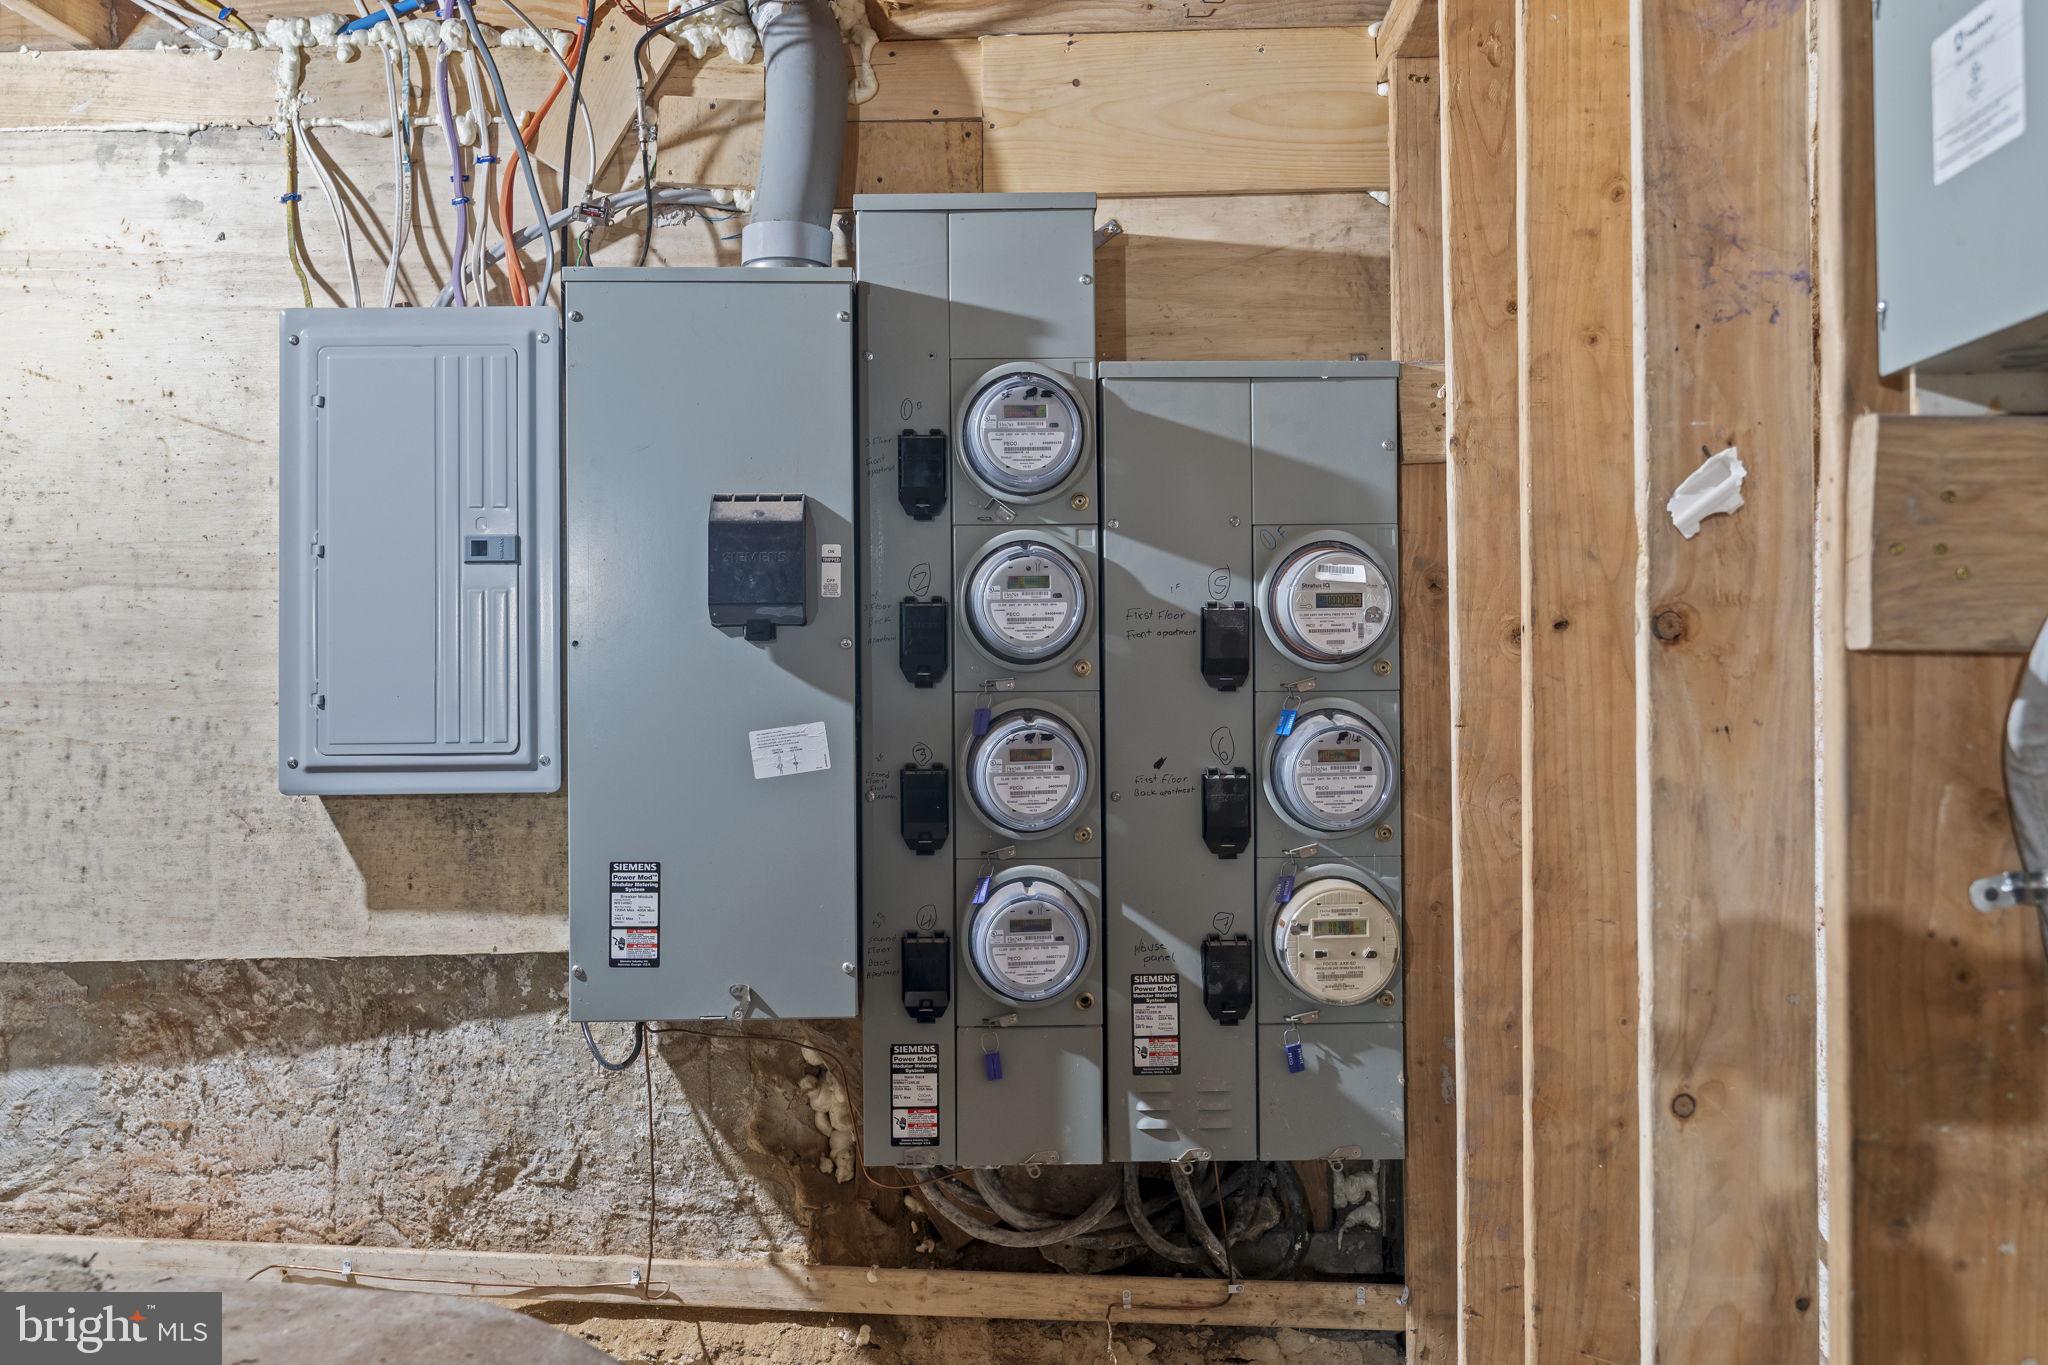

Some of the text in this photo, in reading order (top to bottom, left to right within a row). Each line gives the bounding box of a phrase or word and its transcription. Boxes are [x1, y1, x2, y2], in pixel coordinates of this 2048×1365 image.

[722, 551, 786, 562] SIEMENS
[1126, 607, 1186, 621] First Floor
[1126, 628, 1152, 640] Front
[1136, 773, 1189, 785] First Floor
[1134, 788, 1157, 797] Back
[613, 863, 657, 871] SIEMENS
[1134, 937, 1167, 956] House
[1143, 952, 1175, 967] panel
[1134, 975, 1176, 983] SIEMENS
[894, 1045, 936, 1053] SIEMENS
